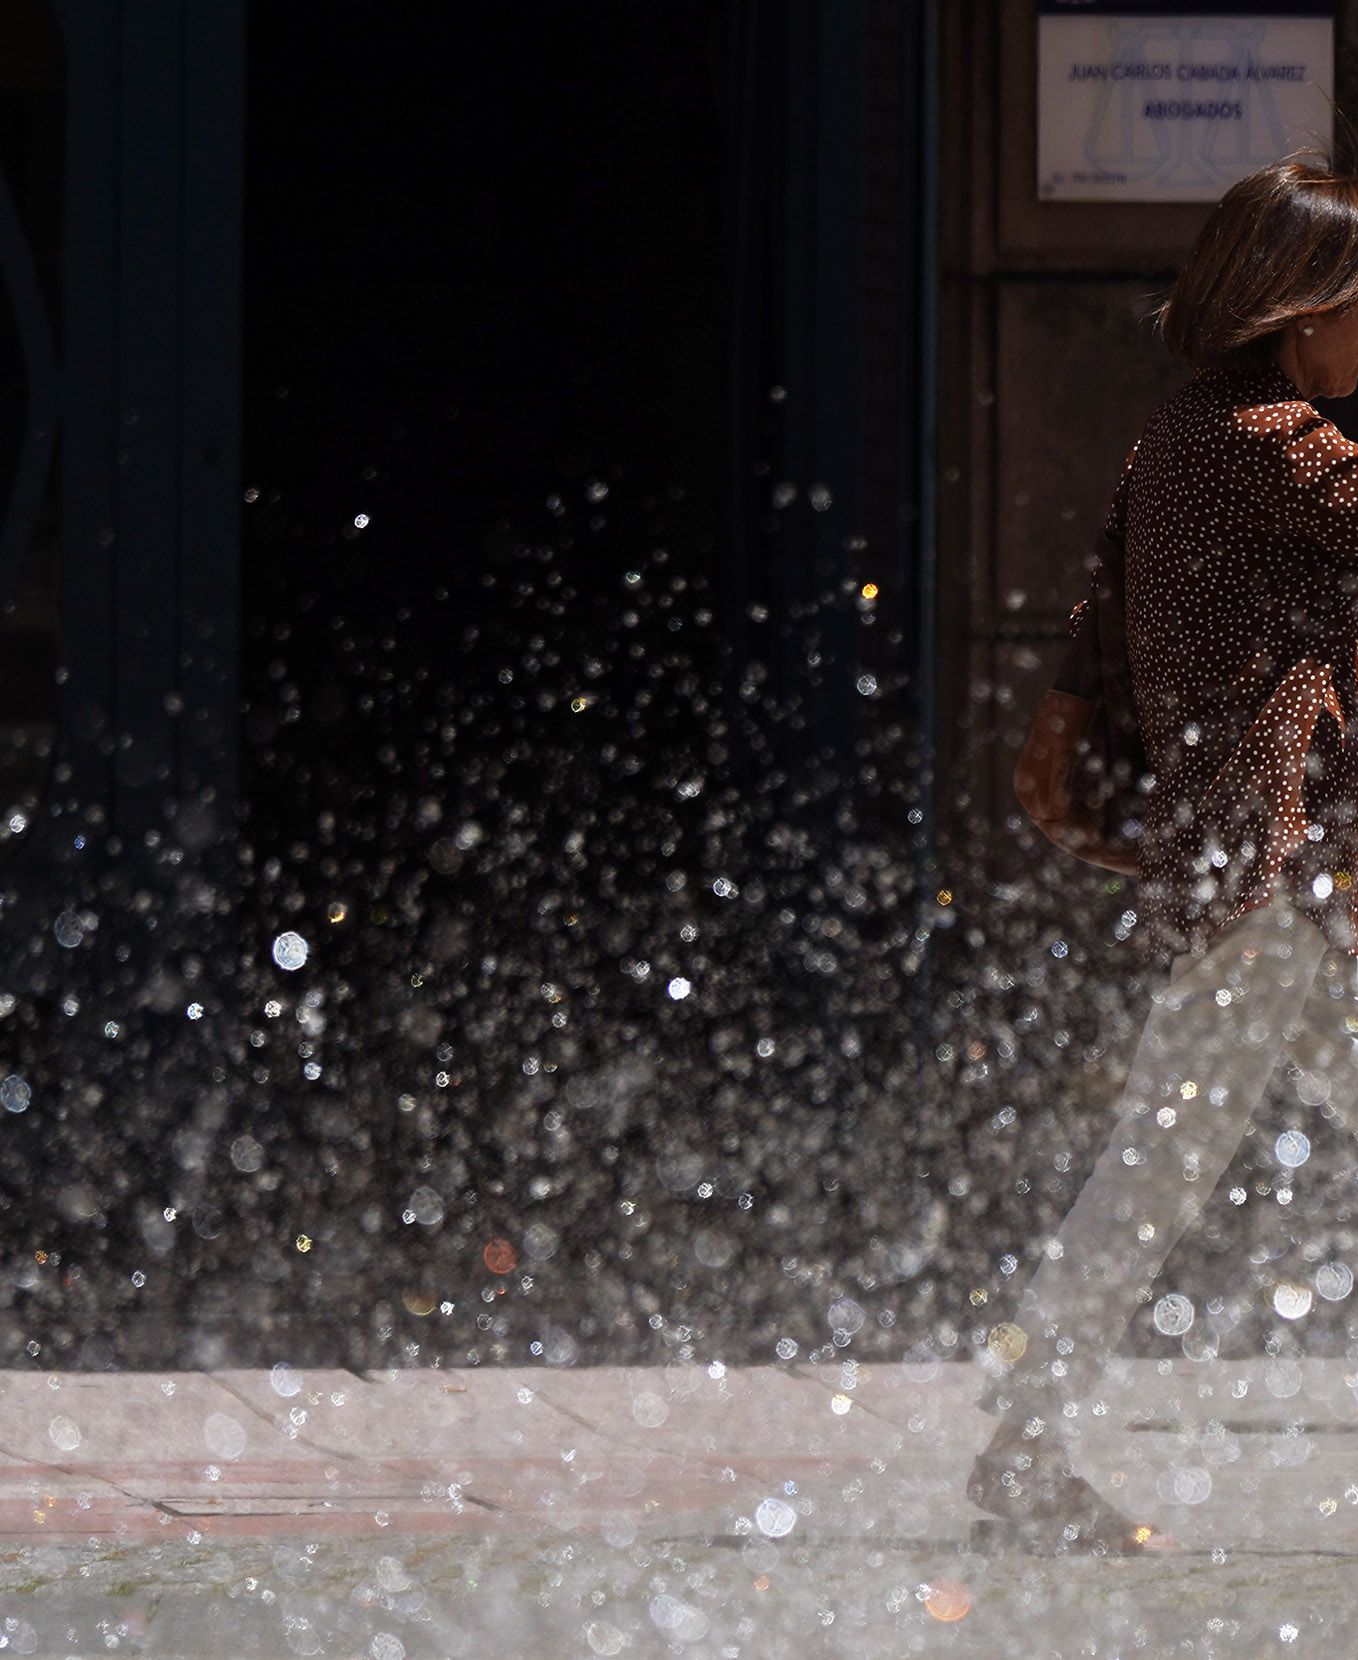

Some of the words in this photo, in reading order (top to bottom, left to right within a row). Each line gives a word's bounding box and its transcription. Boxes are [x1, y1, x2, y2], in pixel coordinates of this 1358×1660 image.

[1070, 63, 1107, 81] JUAN
[1110, 62, 1172, 81] CARLOS
[1142, 101, 1243, 120] ABOGADOS
